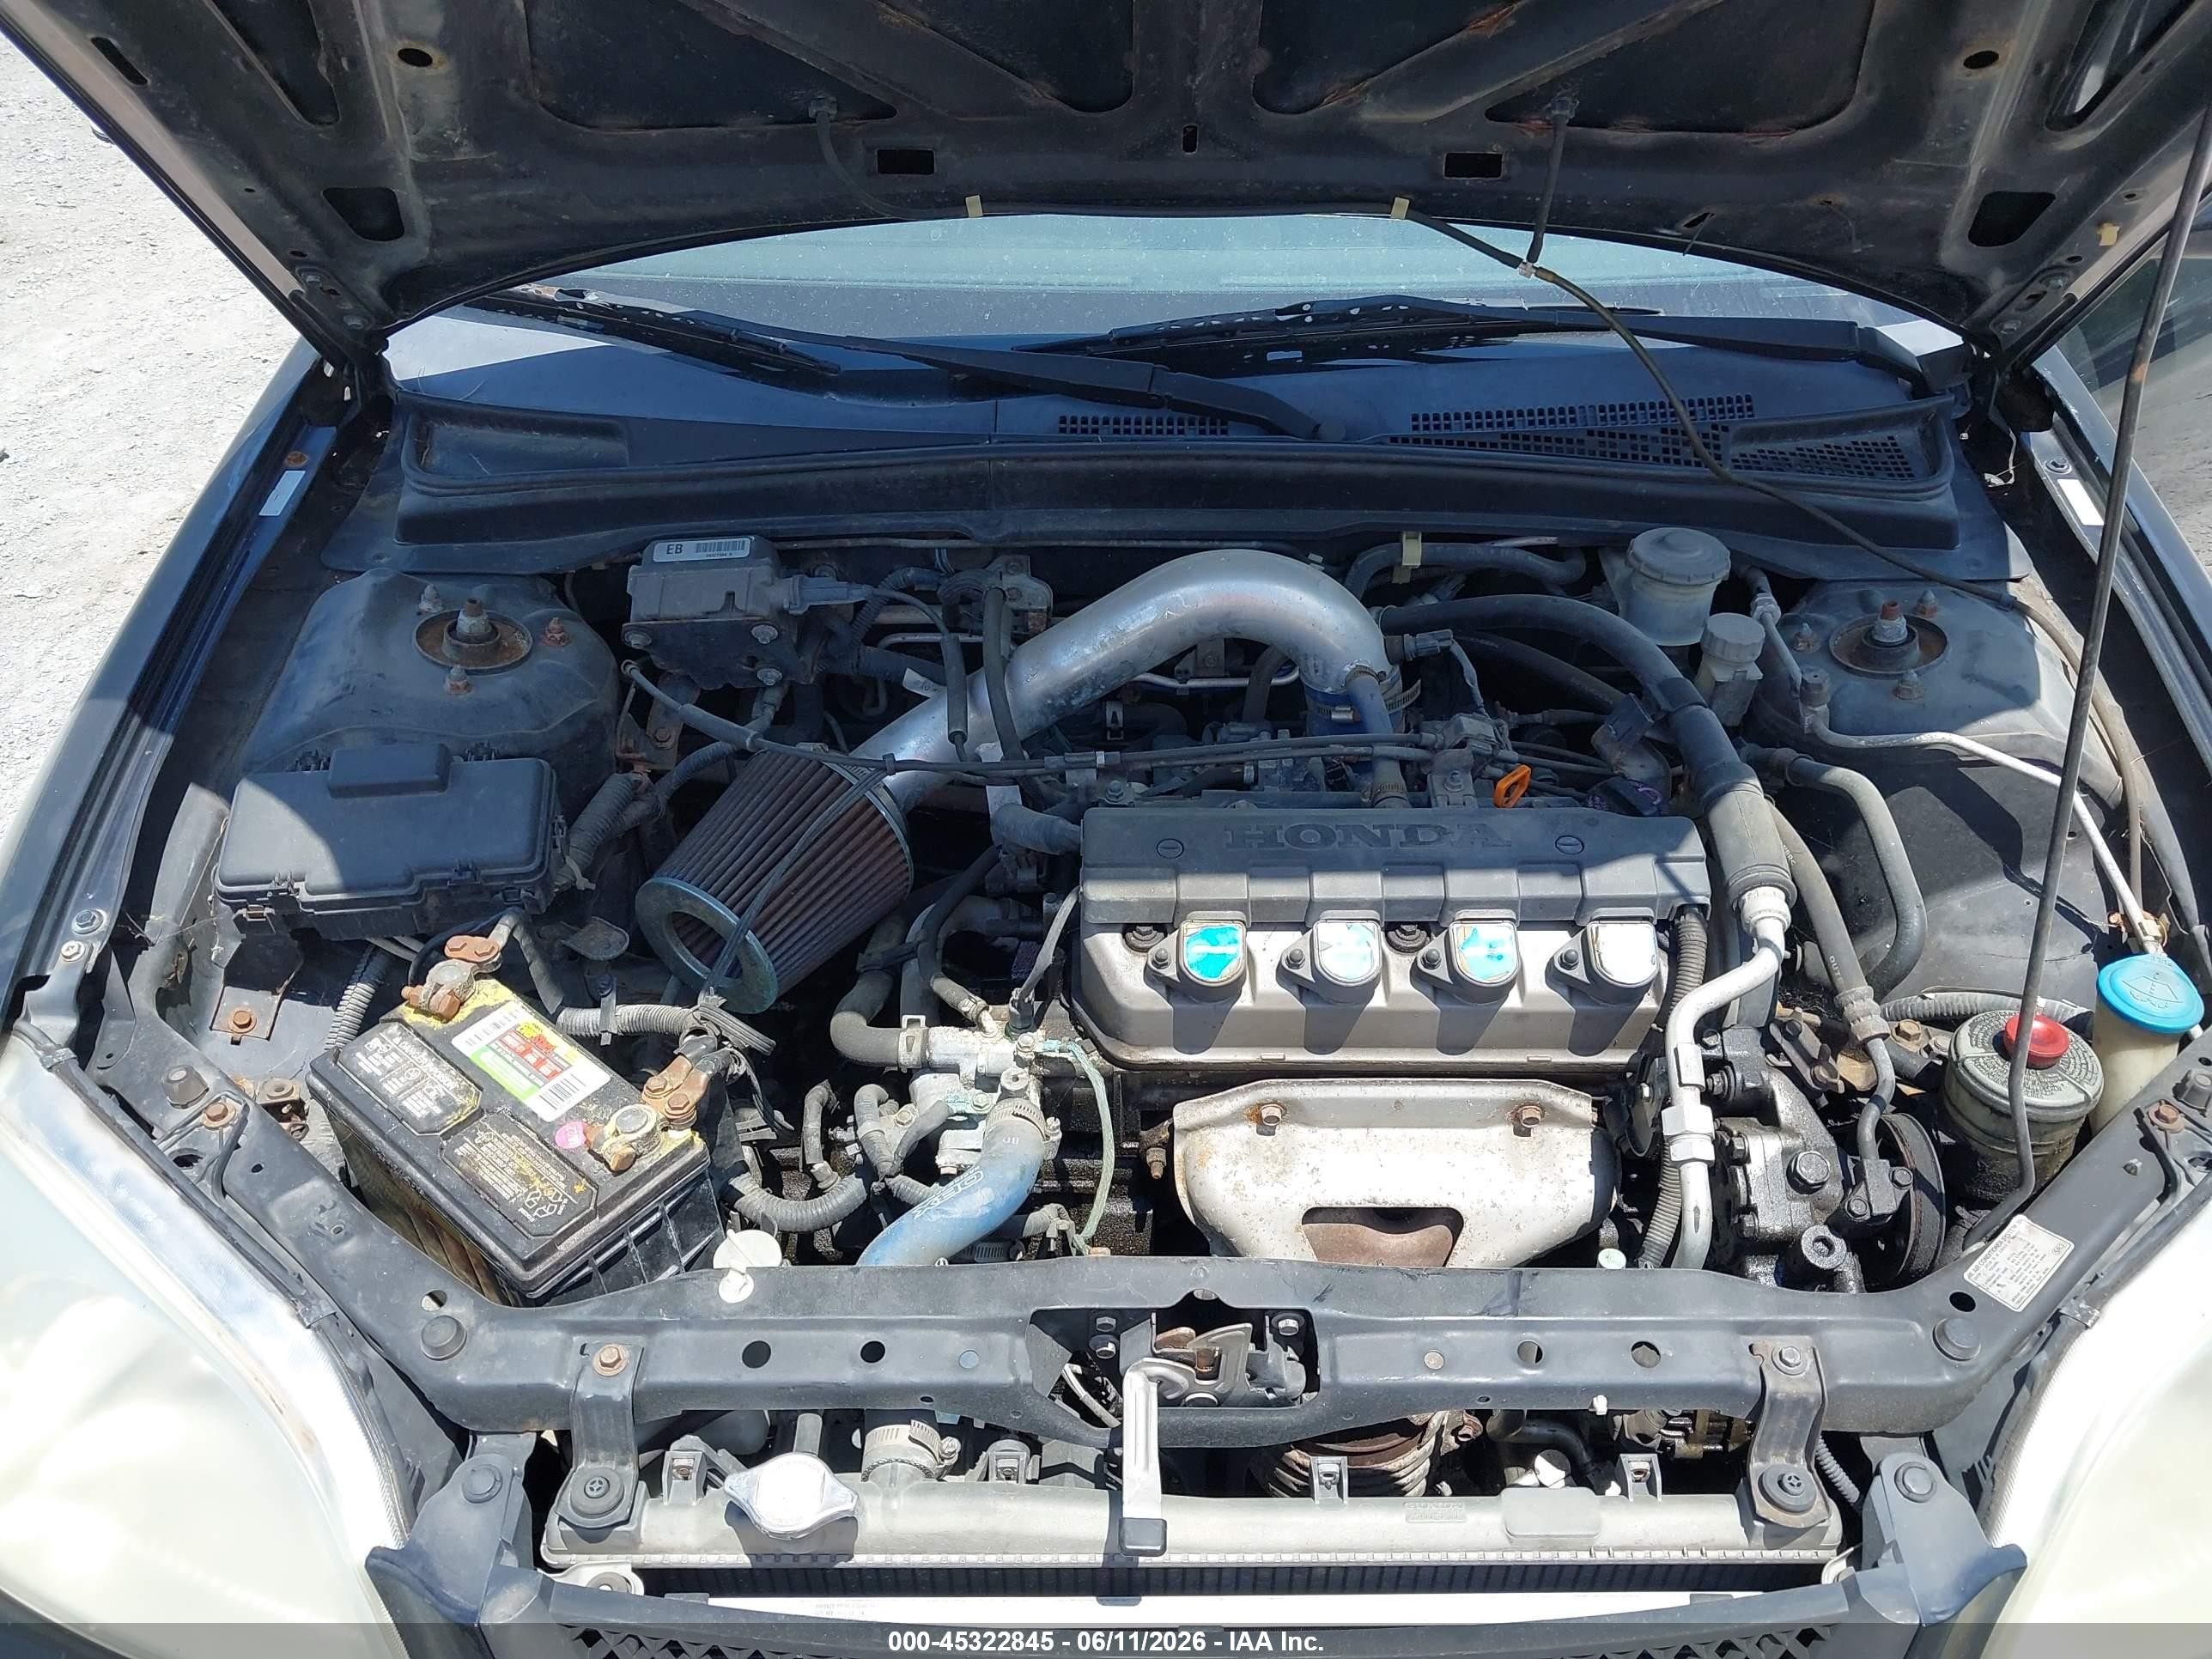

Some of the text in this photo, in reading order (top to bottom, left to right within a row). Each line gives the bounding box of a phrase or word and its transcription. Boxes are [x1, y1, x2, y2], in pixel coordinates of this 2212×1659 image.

[666, 544, 683, 555] EB
[1224, 823, 1512, 850] HONDA
[1978, 1238, 2003, 1267] CONDITIONER
